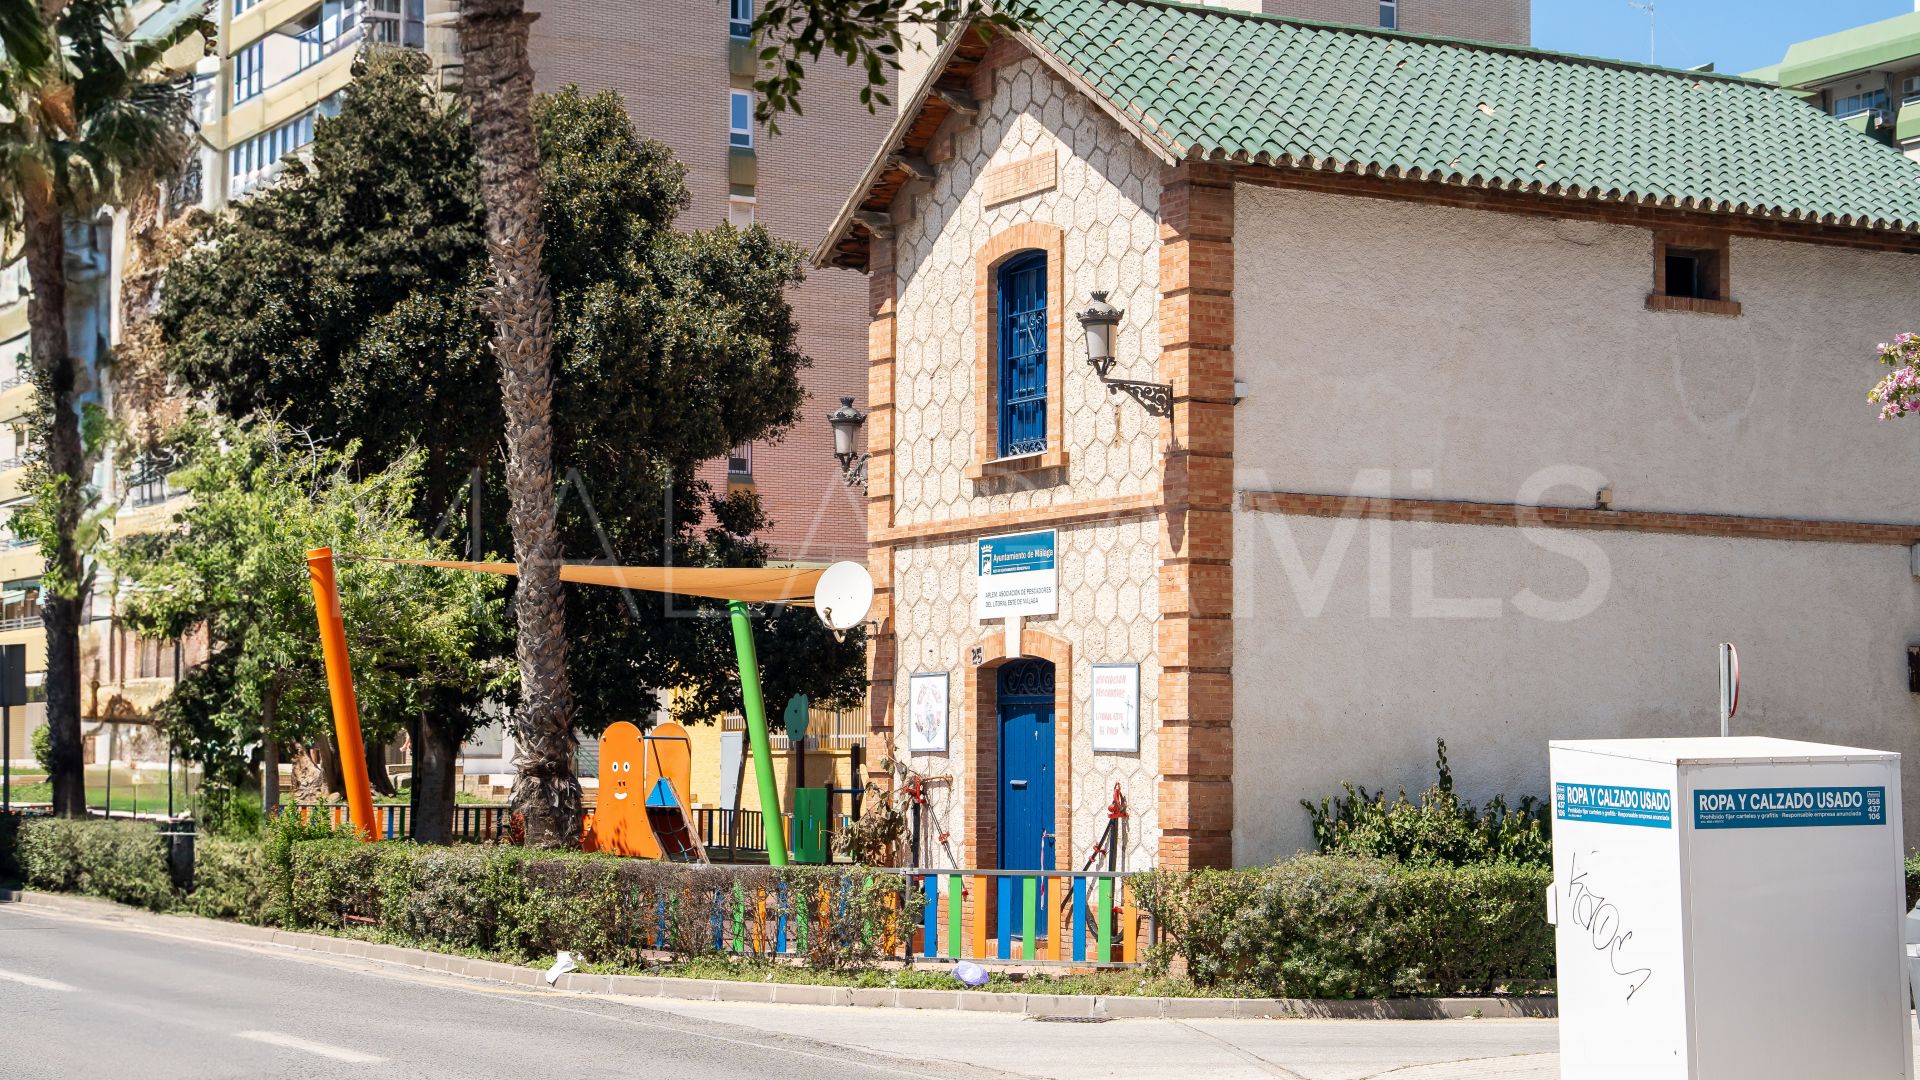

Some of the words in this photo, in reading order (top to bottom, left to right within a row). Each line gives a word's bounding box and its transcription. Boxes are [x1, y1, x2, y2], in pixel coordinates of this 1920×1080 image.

[993, 552, 1026, 563] Ayuntamiento
[1027, 551, 1034, 559] de
[1034, 549, 1053, 559] Málaga
[1567, 786, 1589, 805] ROPA
[1589, 788, 1596, 806] Y
[1597, 789, 1638, 808] CALZADO
[1639, 791, 1670, 811] USADO
[1699, 793, 1736, 811] ROPA
[1737, 793, 1747, 810] Y
[1750, 792, 1814, 810] CALZADO
[1816, 791, 1863, 809] USADO
[1781, 811, 1813, 819] Responsable
